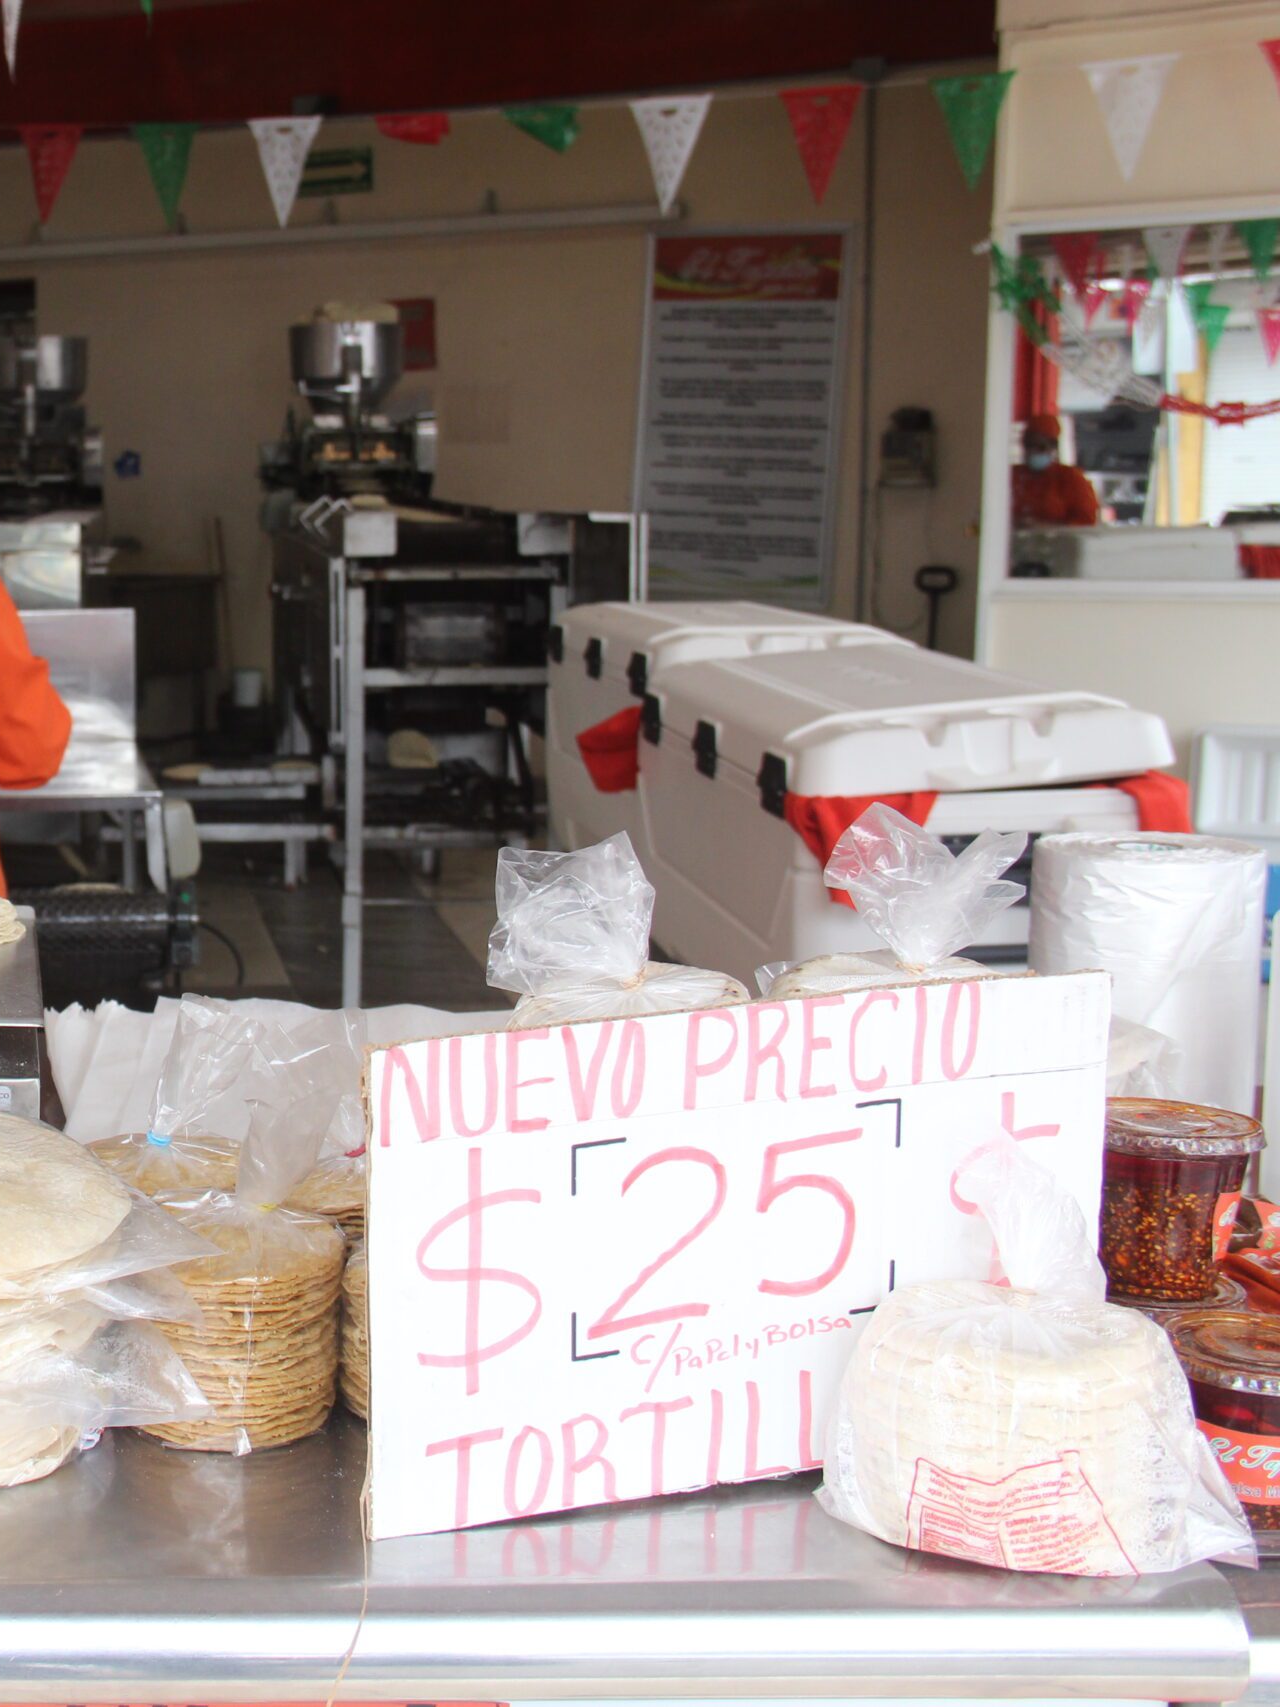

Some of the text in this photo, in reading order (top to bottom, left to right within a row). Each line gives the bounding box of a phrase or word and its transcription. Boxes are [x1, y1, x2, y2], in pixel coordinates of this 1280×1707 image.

[380, 982, 981, 1147] NUEVO PRECIO
[1231, 1482, 1262, 1497] alsa
